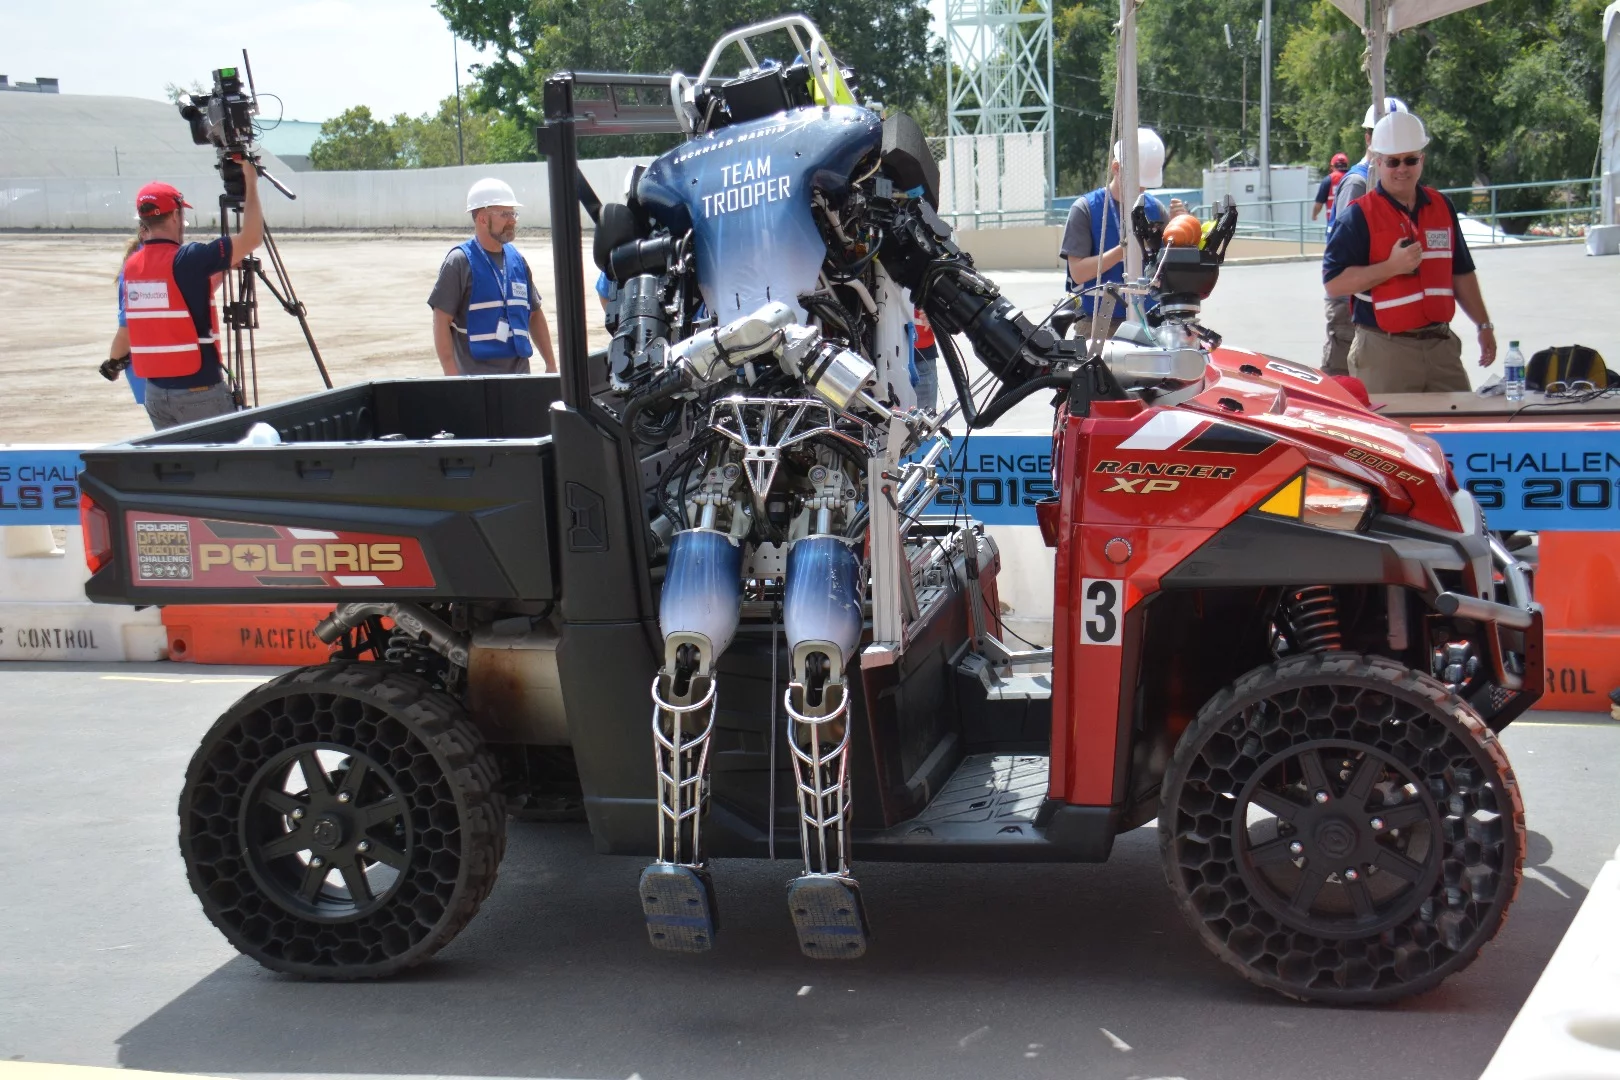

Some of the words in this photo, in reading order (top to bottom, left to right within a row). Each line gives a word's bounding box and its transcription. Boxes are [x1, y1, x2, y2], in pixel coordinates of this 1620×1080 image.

[737, 125, 786, 143] MARTIN
[721, 155, 771, 187] TEAM
[702, 175, 791, 218] TROOPER
[139, 291, 168, 300] Production
[1093, 460, 1236, 480] RANGER
[1344, 447, 1398, 474] 900
[1396, 471, 1425, 486] EFI
[933, 476, 1057, 507] 2015
[1100, 477, 1180, 494] XP
[137, 523, 188, 532] POLARIS
[138, 532, 189, 545] DARPA
[139, 545, 190, 556] ROBOTICS
[140, 555, 190, 563] CHALLENGE
[199, 543, 404, 572] POLARIS
[1086, 581, 1117, 643] 3
[17, 628, 99, 649] CONTROL
[239, 627, 317, 650] PACIFIC
